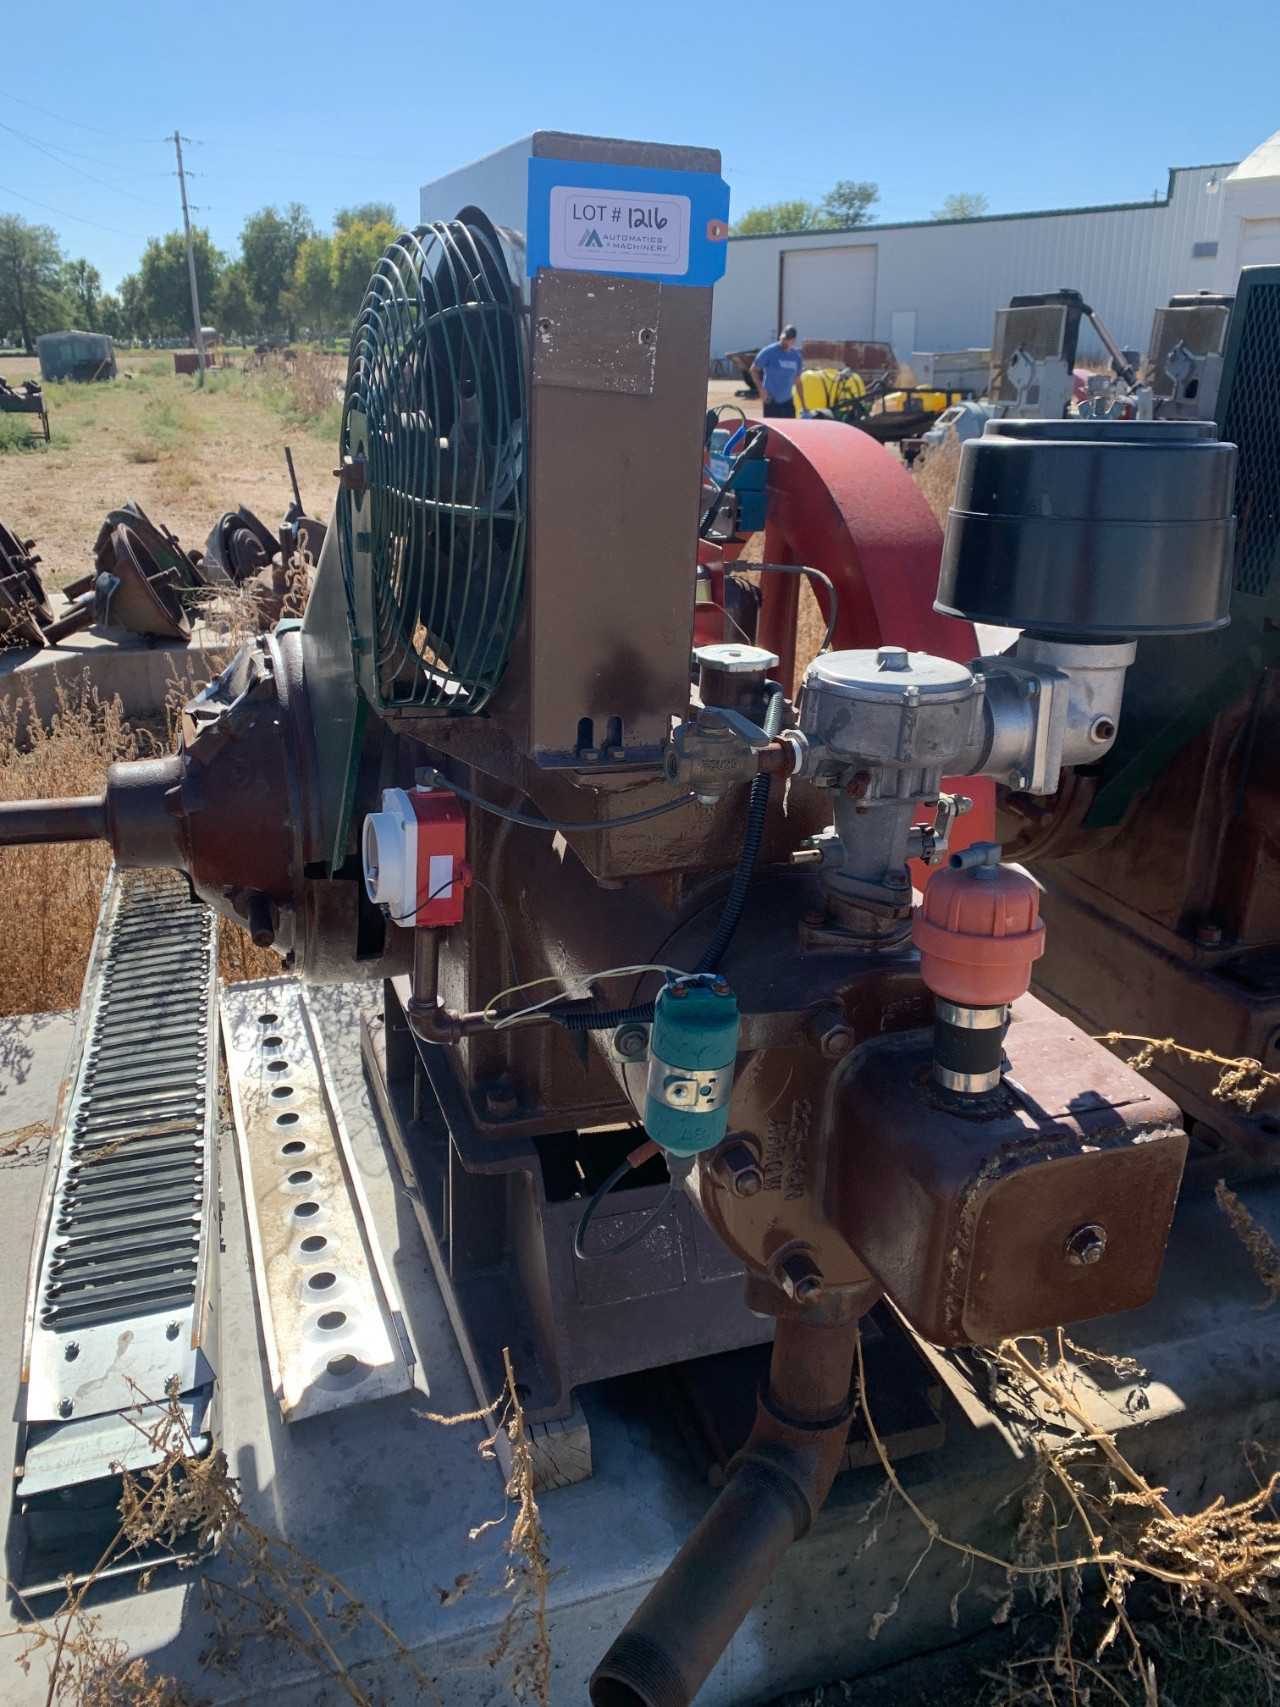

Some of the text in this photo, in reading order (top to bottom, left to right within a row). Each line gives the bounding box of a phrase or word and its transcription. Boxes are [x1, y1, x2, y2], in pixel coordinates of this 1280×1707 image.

[572, 203, 668, 229] LOT # 1216
[603, 233, 663, 243] AUTOMATICS
[612, 242, 668, 252] MACHINERY
